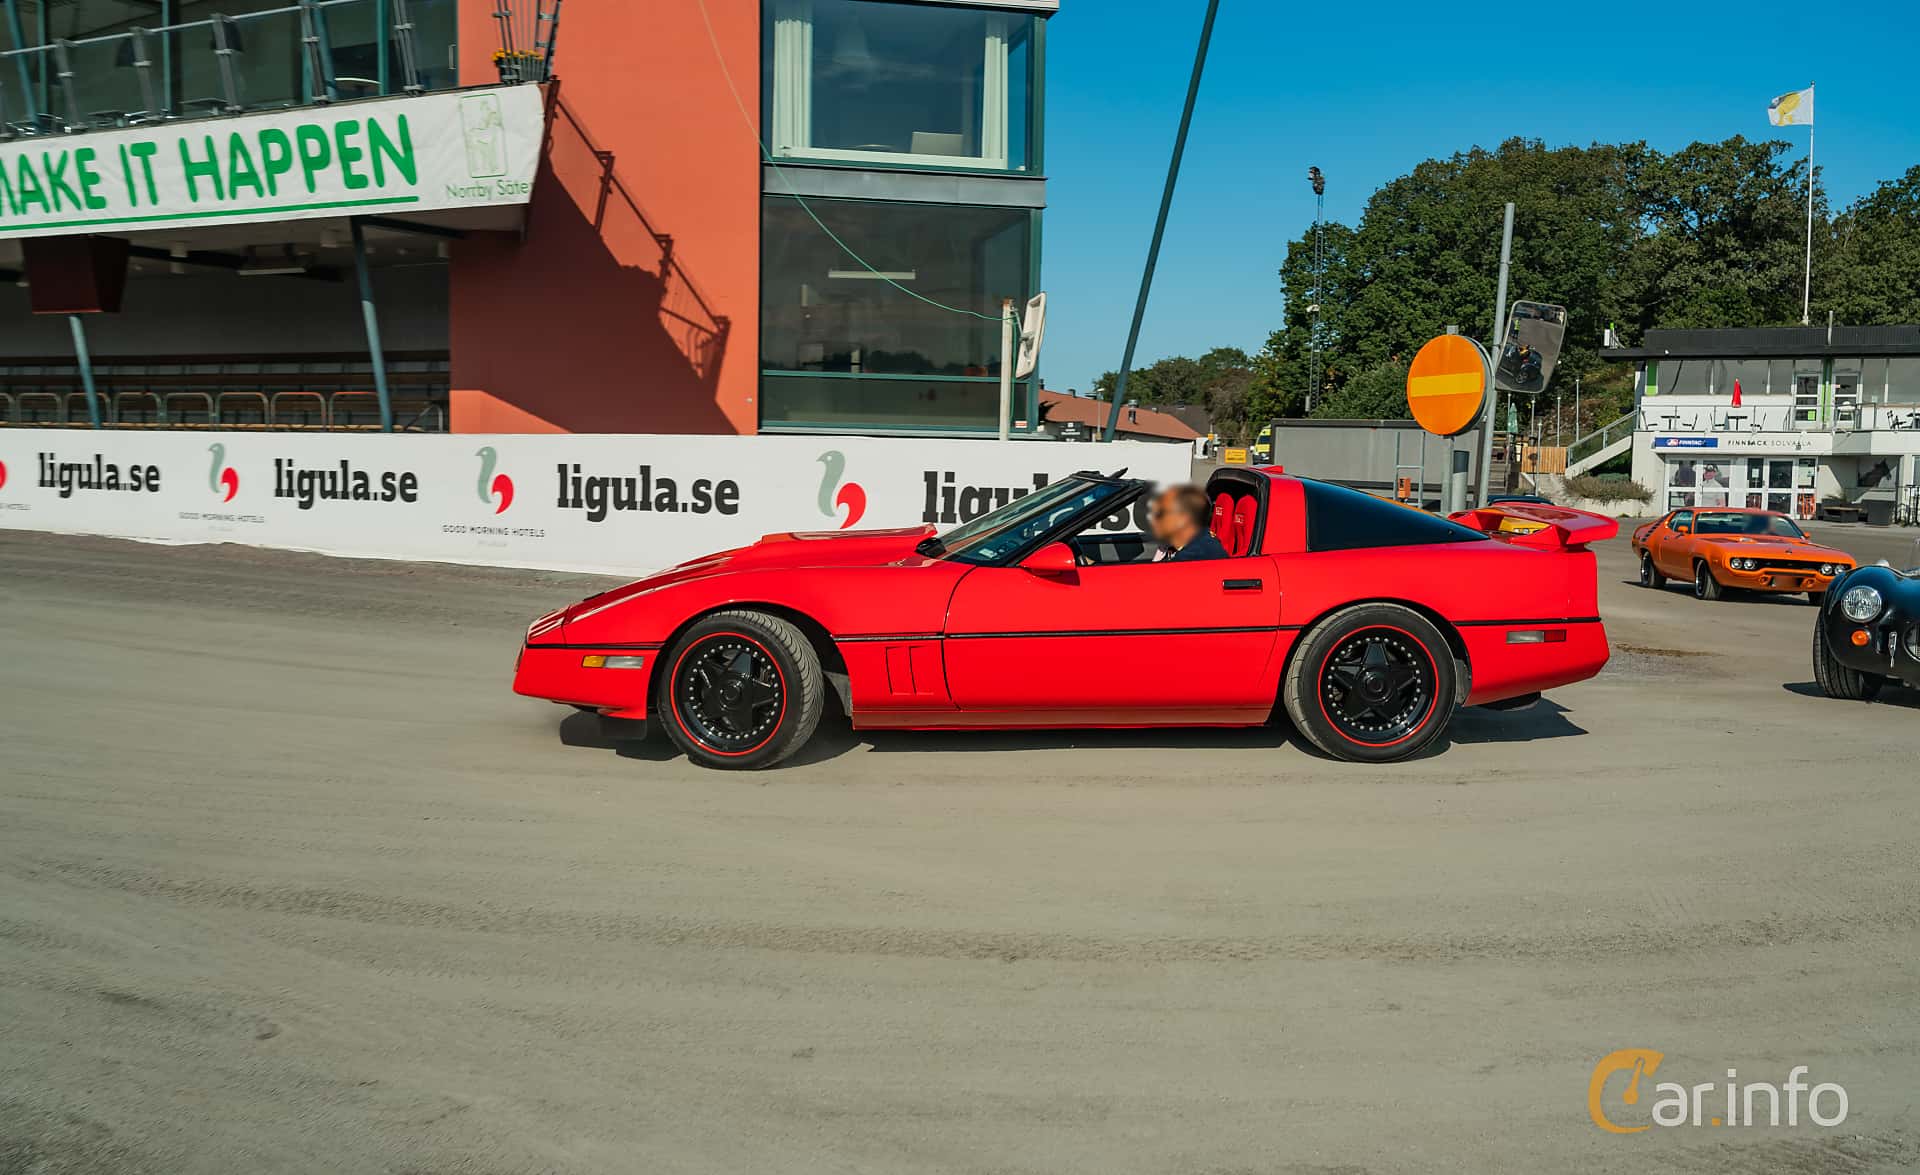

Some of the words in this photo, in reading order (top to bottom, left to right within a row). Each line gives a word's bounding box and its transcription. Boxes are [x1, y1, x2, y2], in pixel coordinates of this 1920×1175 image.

[118, 142, 158, 207] IT
[179, 114, 417, 196] HAPPEN
[38, 452, 160, 498] ligula.se
[274, 458, 417, 510] ligula.se
[557, 464, 740, 522] ligula.se
[442, 524, 466, 534] GOOD
[470, 526, 509, 536] MORNING
[512, 528, 545, 538] HOTELS
